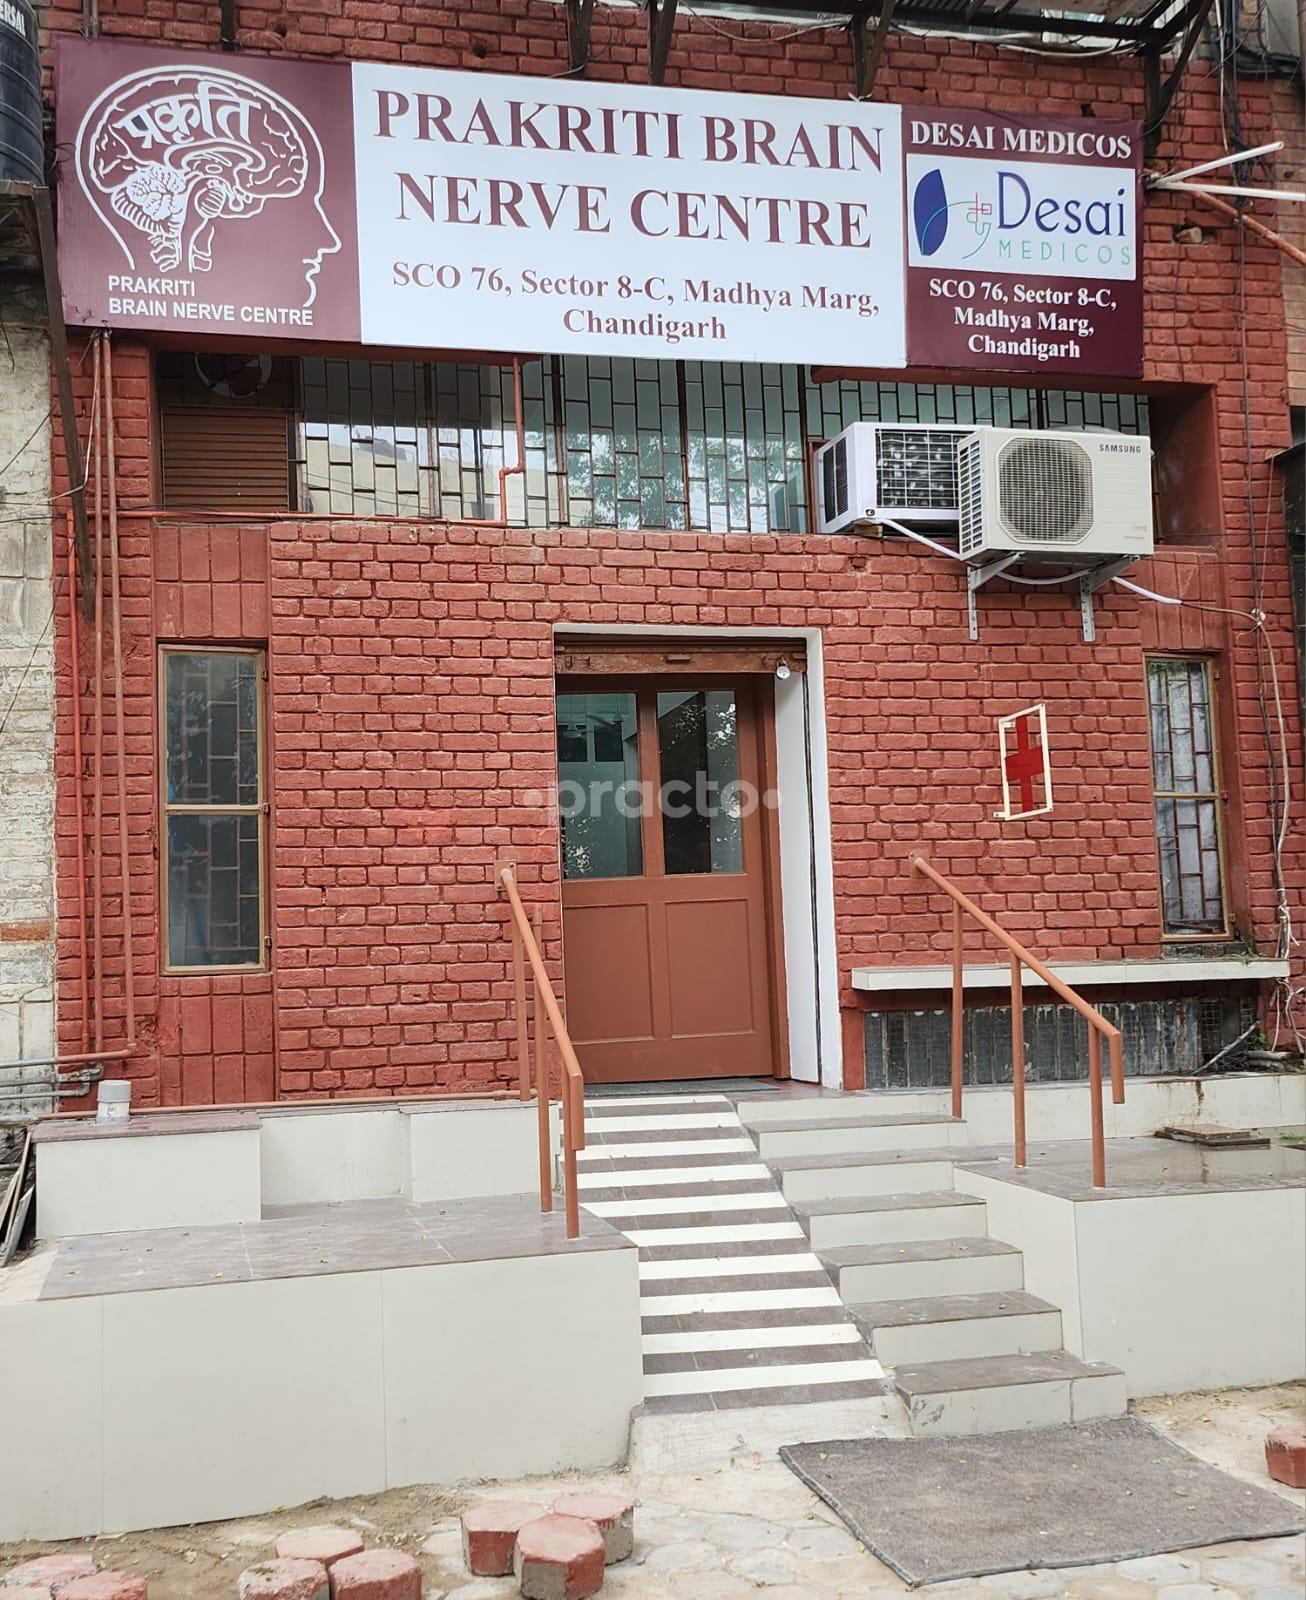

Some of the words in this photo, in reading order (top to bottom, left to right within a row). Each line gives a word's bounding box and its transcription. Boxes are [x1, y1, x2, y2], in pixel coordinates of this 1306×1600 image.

[111, 80, 262, 149] प्रकृति
[372, 89, 685, 160] PRAKRITI
[700, 114, 885, 173] BRAIN
[910, 120, 995, 150] DESAI
[1003, 127, 1132, 159] MEDICOS
[394, 172, 612, 233] NERVE
[630, 189, 872, 248] CENTRE
[996, 171, 1127, 237] Desai
[999, 239, 1132, 265] MEDICOS
[108, 275, 196, 297] PRAKRITI
[392, 261, 461, 289] SCO
[471, 267, 512, 296] 76,
[521, 269, 609, 296] Sector
[617, 275, 675, 305] 8-C,
[683, 278, 792, 312] Madhya
[802, 285, 880, 317] Marg,
[929, 278, 975, 299] SCO
[981, 282, 1009, 304] 76,
[1013, 283, 1073, 305] Sector
[1077, 287, 1117, 311] 8-C,
[108, 298, 167, 317] BRAIN
[172, 302, 235, 321] NERVE
[240, 306, 314, 326] CENTRE
[563, 308, 727, 343] Chandigarh
[954, 306, 1031, 332] Madhya
[1038, 312, 1095, 337] Marg,
[967, 334, 1081, 361] Chandigarh
[1099, 444, 1142, 454] SAMSUNG
